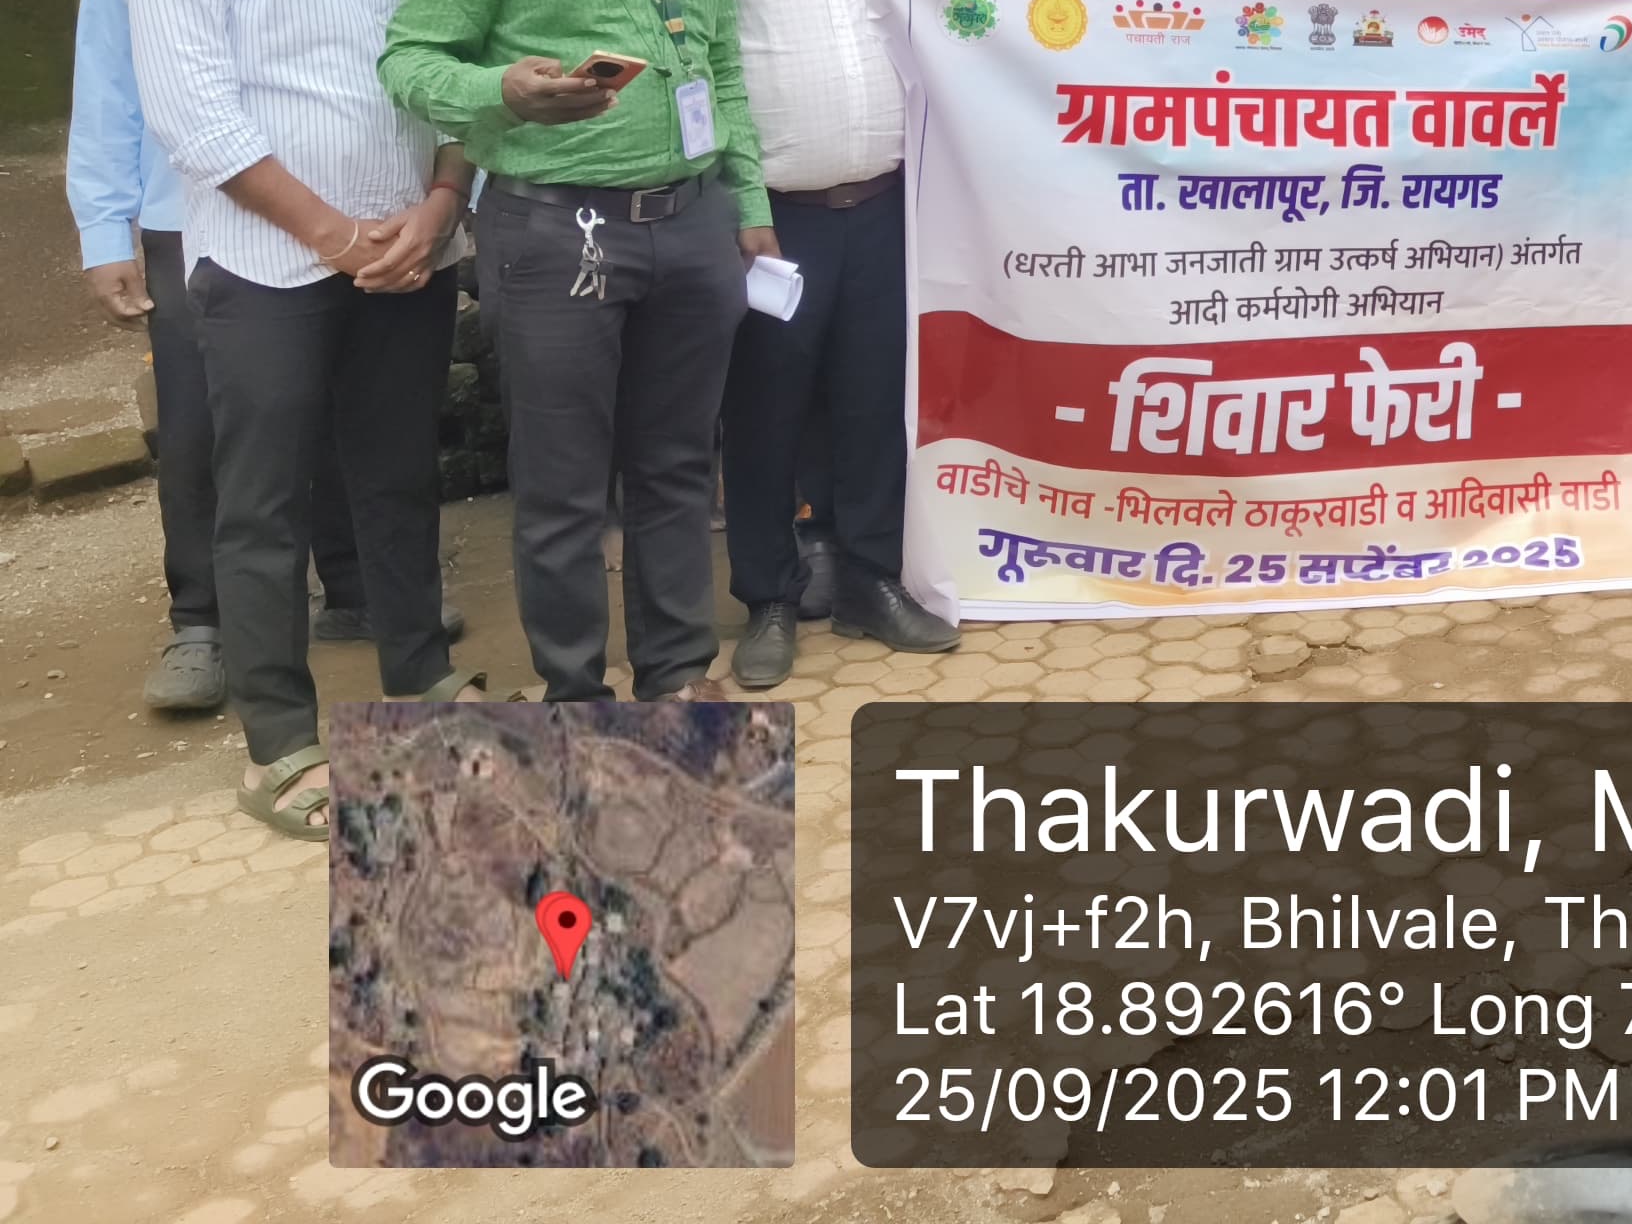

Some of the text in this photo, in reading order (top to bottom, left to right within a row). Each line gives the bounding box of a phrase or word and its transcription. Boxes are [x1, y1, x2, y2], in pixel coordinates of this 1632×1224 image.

[1056, 69, 1567, 149] ग्रामपंचायत वावर्ले
[1119, 164, 1502, 222] ता. खालापूर, जि. रायगड
[1002, 234, 1582, 282] (धरती आभा जनजाती ग्राम उत्कर्ष अभियान) अंतर्गत
[1168, 288, 1442, 326] आदी कर्मयोगी अभियान
[1109, 355, 1334, 456] शिवार
[1345, 342, 1484, 445] फेरी
[936, 457, 1621, 537] वाडीचे नाव -भिलवले ठाकूरवाडी व आदिवासी वाडी
[1154, 541, 1212, 588] दि.
[1224, 554, 1287, 584] 25
[1298, 545, 1452, 584] सप्टेंबर
[1461, 537, 1582, 569] 2025
